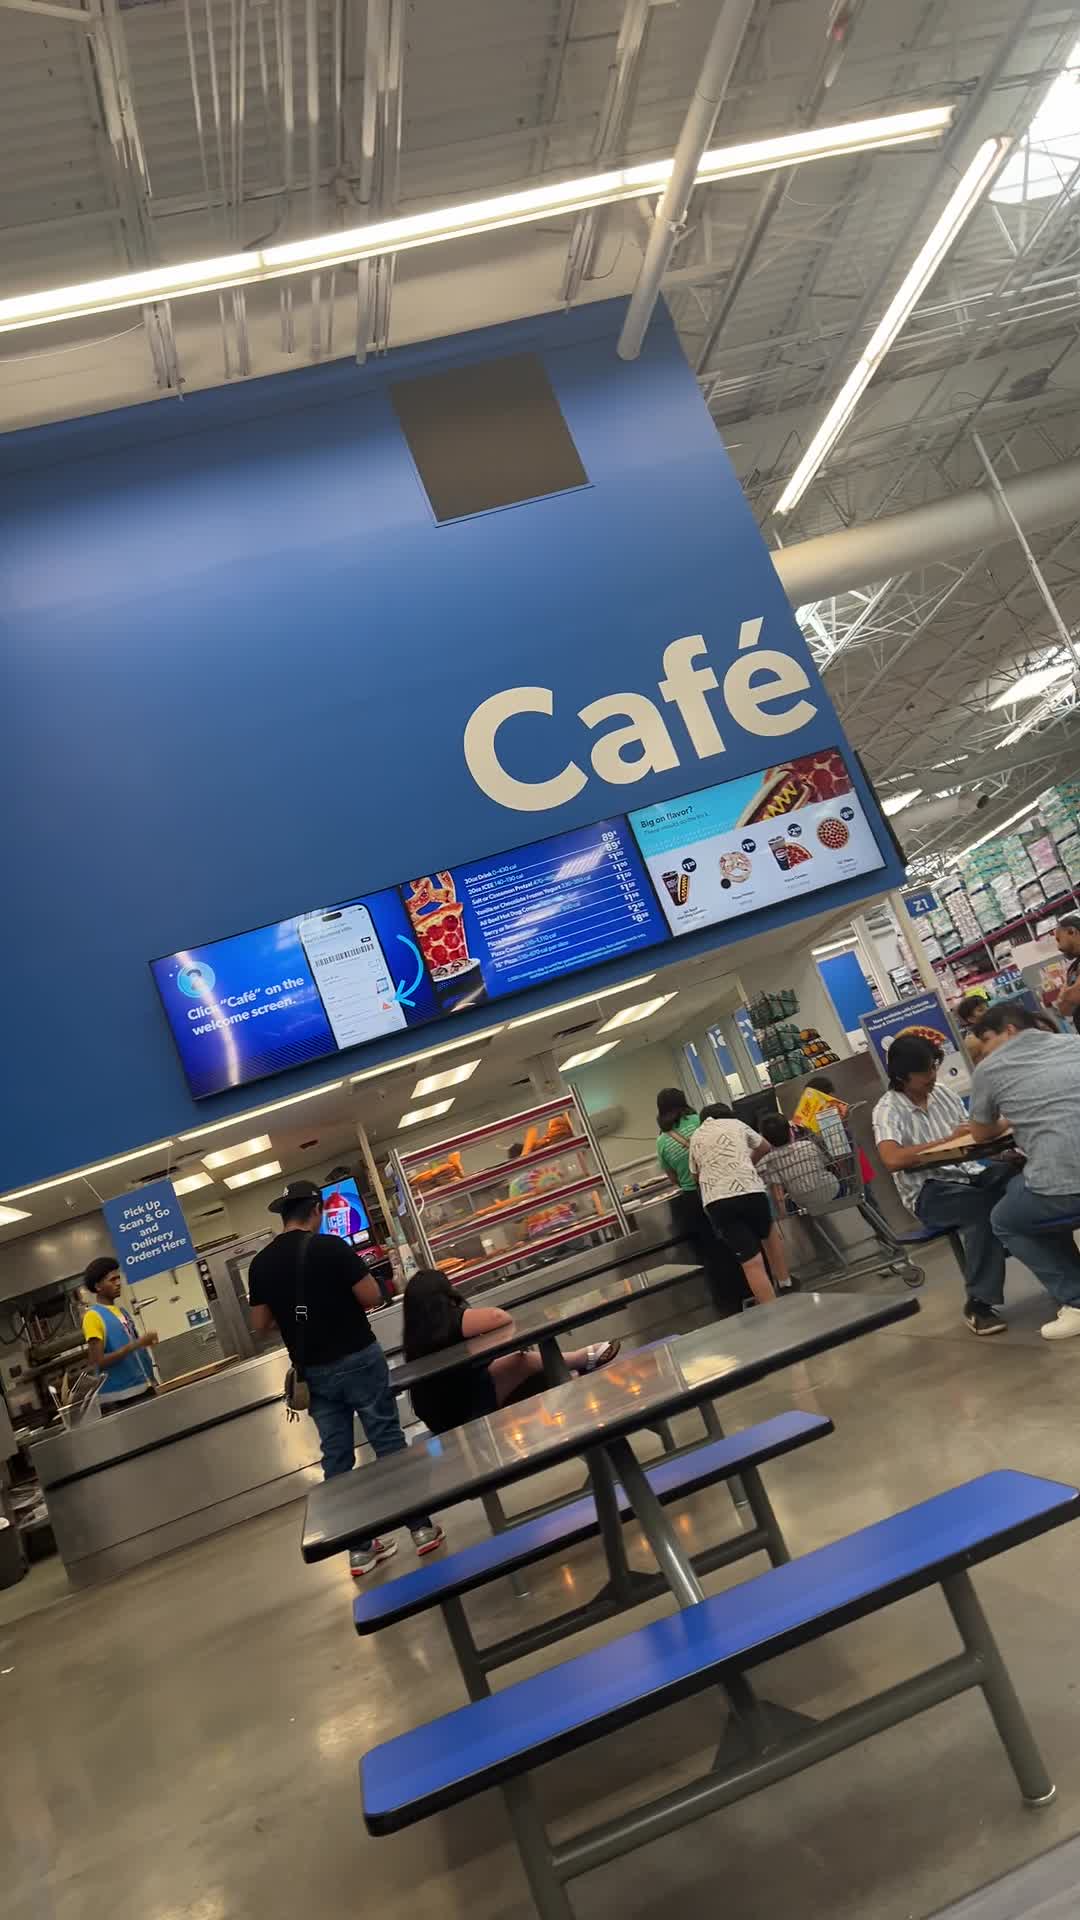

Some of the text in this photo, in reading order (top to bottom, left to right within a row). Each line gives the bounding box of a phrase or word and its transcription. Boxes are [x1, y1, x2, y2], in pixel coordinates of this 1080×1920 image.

[464, 616, 818, 811] Café
[639, 805, 693, 829] Big on flavor?
[477, 870, 492, 880] Drink
[514, 872, 524, 880] cal
[514, 880, 533, 891] Pretzel
[525, 889, 544, 900] Frozen
[542, 884, 561, 895] Yogurt
[499, 912, 510, 920] Hot
[509, 908, 522, 917] Dog
[913, 898, 930, 912] Z1
[263, 982, 282, 996] on
[282, 974, 305, 990] the
[191, 994, 296, 1036] welcome screen.
[122, 1198, 161, 1219] Pick Up
[117, 1206, 170, 1233] Scan & Go
[138, 1222, 159, 1237] and
[125, 1234, 187, 1266] Orders Here
[130, 1228, 175, 1253] Delivery
